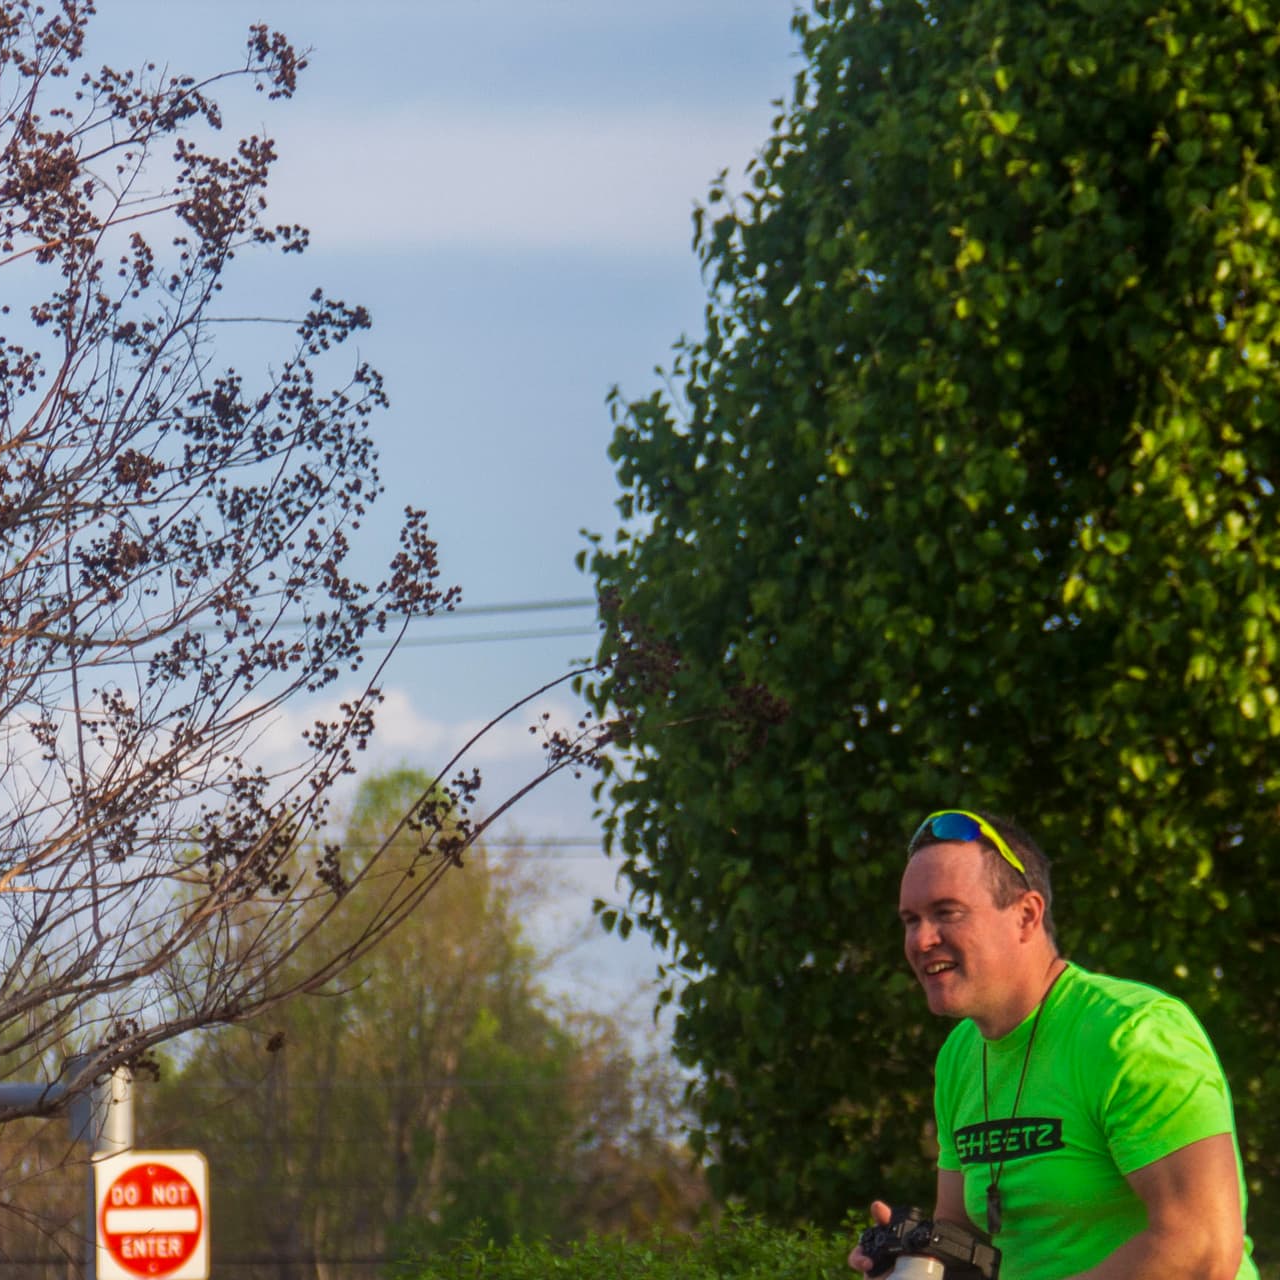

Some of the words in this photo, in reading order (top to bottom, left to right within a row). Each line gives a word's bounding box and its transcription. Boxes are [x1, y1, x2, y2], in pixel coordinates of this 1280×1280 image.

[956, 1123, 1054, 1159] SHEETZ
[111, 1183, 139, 1206] DO
[151, 1183, 189, 1205] NOT
[121, 1235, 182, 1259] ENTER
